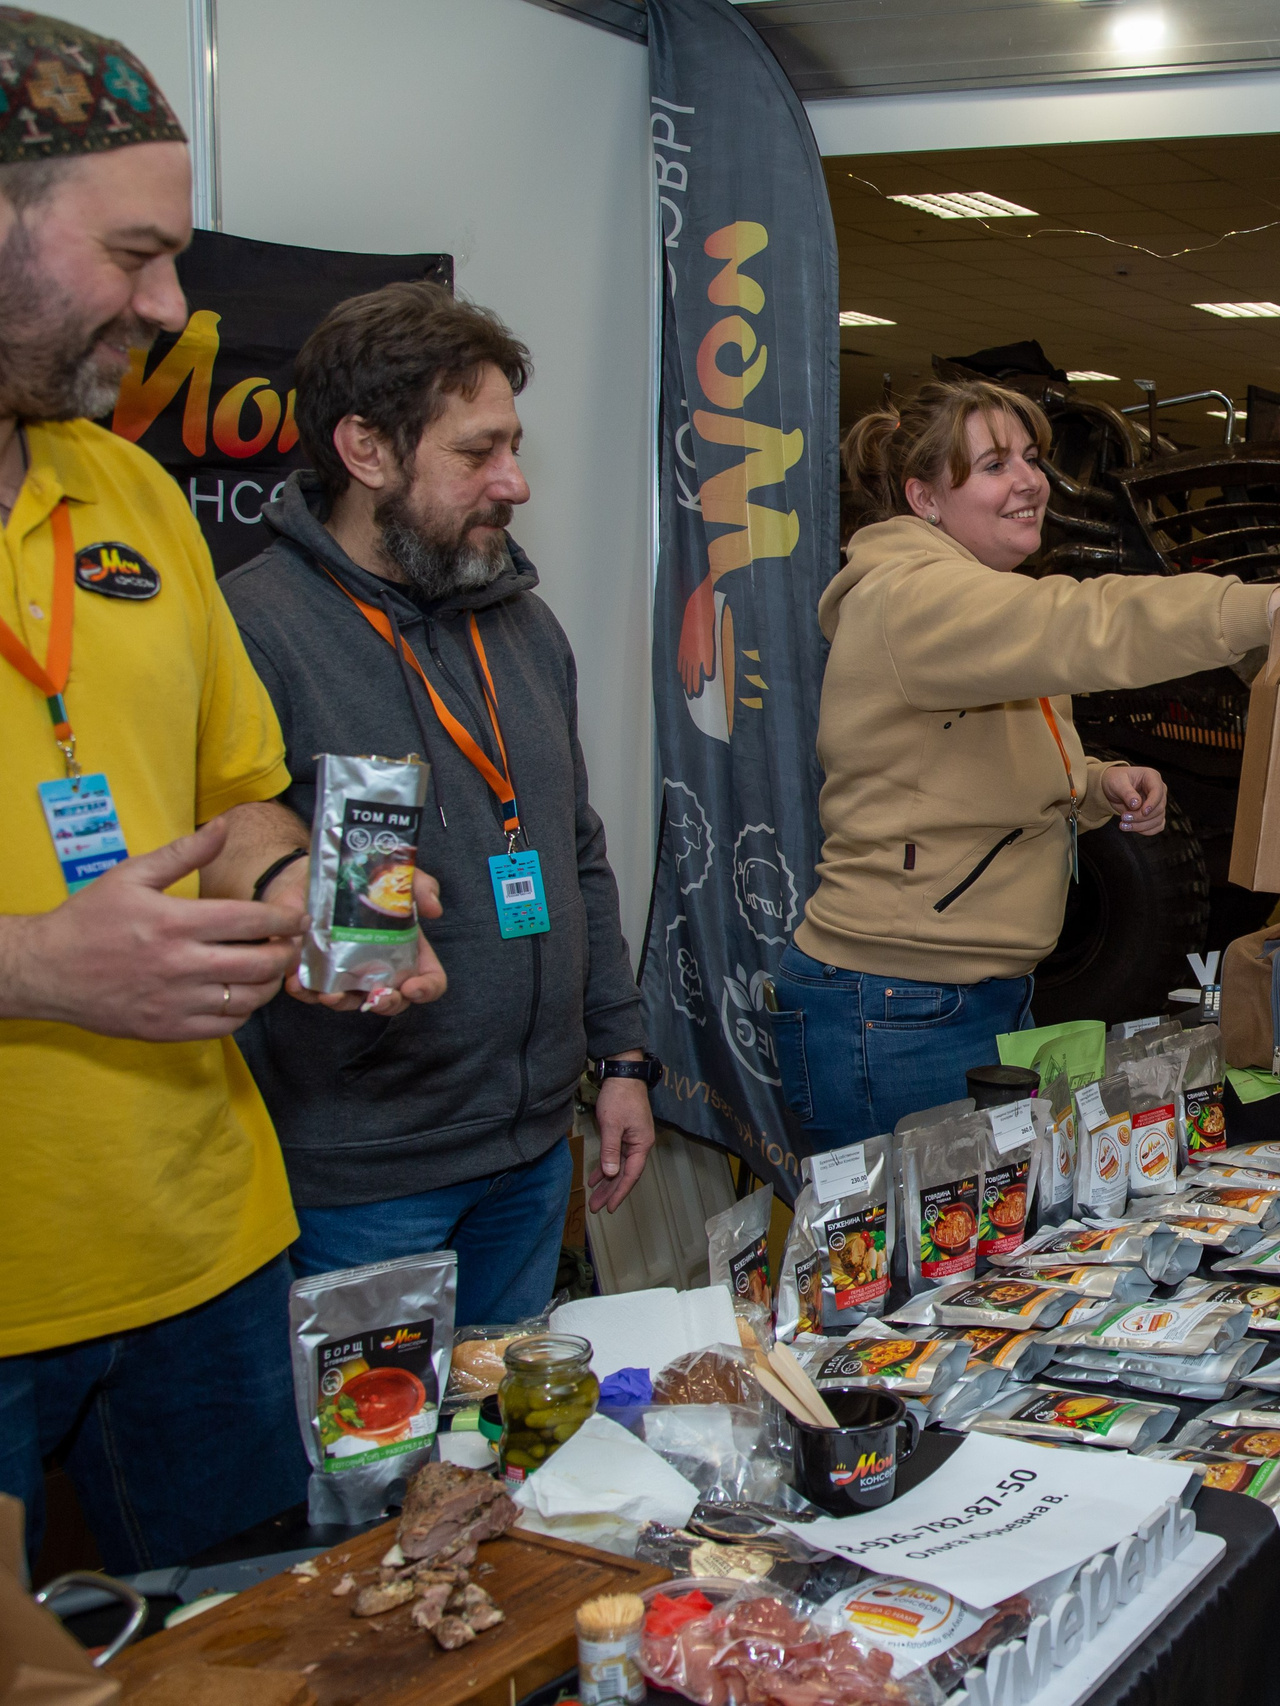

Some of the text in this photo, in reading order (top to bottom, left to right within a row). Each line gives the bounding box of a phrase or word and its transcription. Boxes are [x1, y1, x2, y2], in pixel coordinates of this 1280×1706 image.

[351, 809, 410, 827] ТОМ ЯМ
[827, 1215, 862, 1232] БУЖЕНИНА
[324, 1341, 363, 1361] БОРЩ
[856, 1452, 894, 1479] Мои
[834, 1468, 1038, 1556] 8-926-782-87-50
[905, 1491, 1069, 1561] Ольга Юрьевна В.
